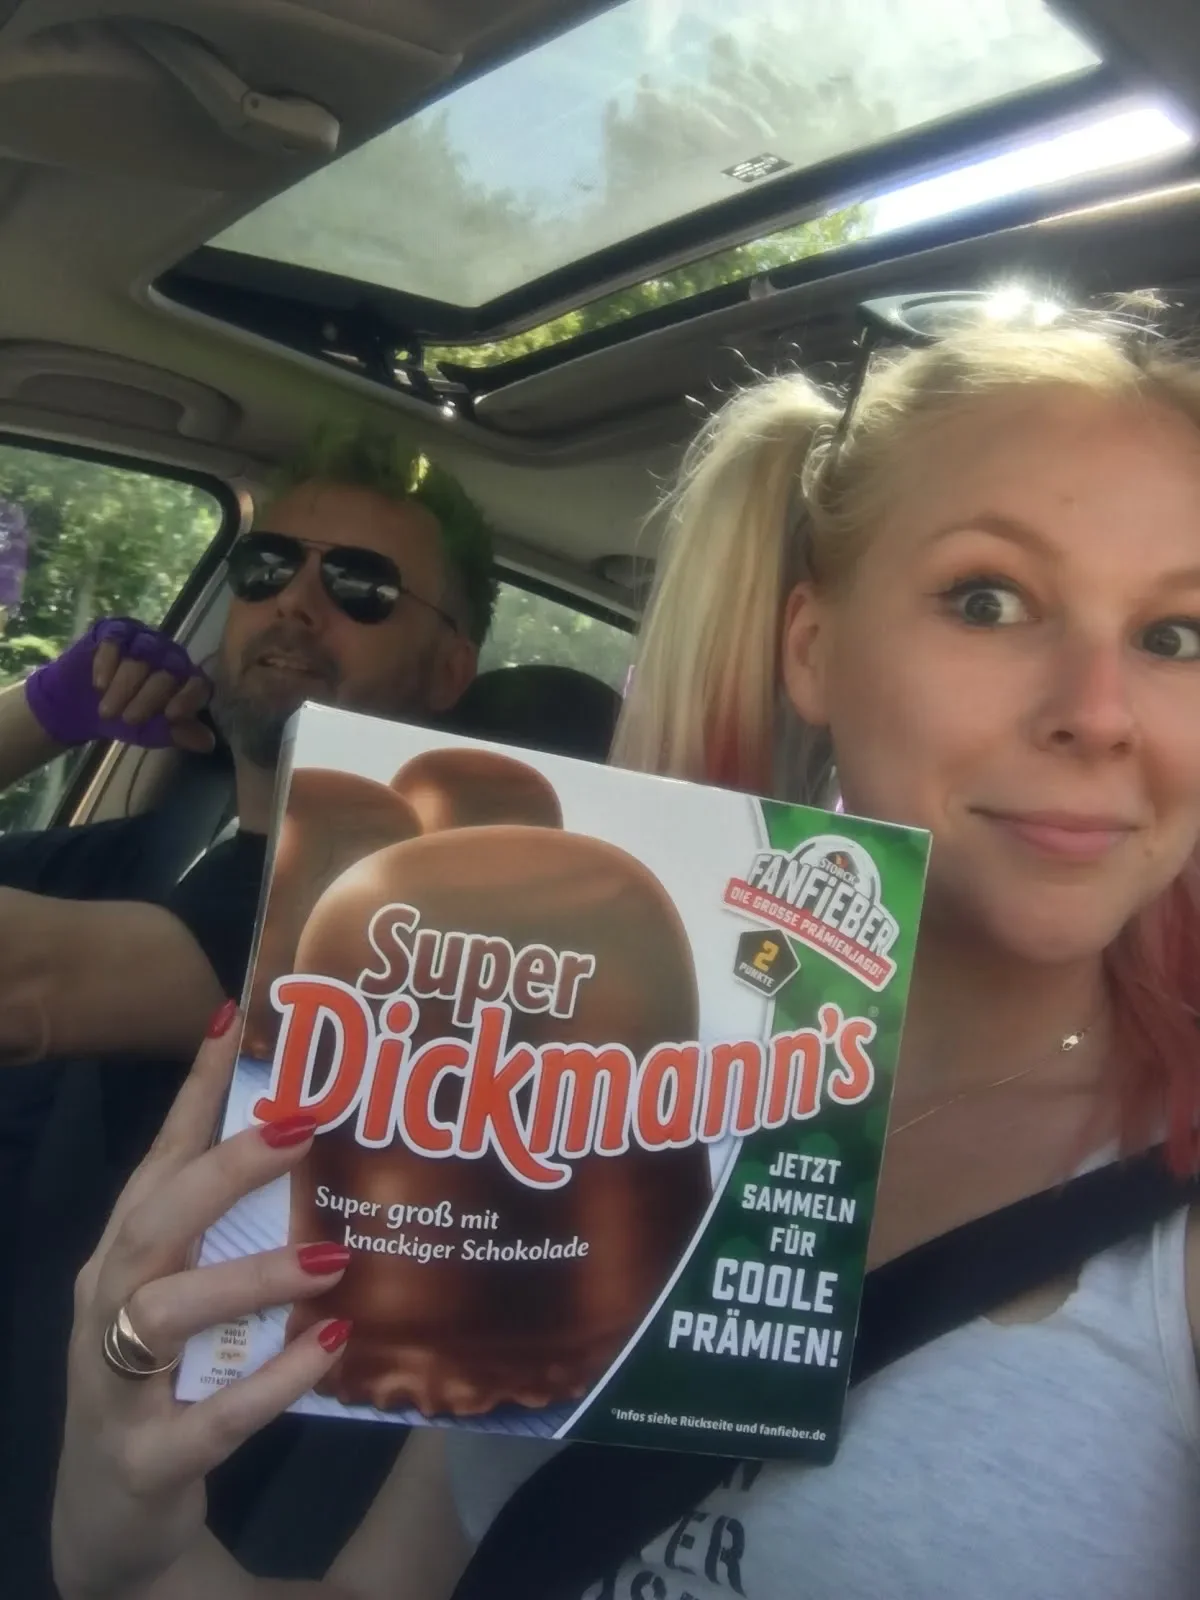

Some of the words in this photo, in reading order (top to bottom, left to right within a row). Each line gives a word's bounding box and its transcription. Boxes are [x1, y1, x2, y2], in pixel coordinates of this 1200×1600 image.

[819, 857, 857, 885] STORCK
[730, 886, 752, 905] DIE
[754, 894, 800, 927] GROSSE
[801, 918, 884, 979] PRÄMIENJAGD!
[356, 903, 595, 1027] Super
[738, 961, 776, 988] PUNKTE
[753, 940, 779, 972] 2
[253, 974, 877, 1190] Dickmann's
[769, 1151, 841, 1185] JETZT
[315, 1186, 381, 1218] Super
[386, 1201, 454, 1229] groß
[461, 1209, 500, 1230] mit
[741, 1183, 856, 1224] SAMMELN
[344, 1225, 456, 1264] knackiger
[461, 1235, 590, 1262] Schokolade
[770, 1223, 816, 1258] FÜR
[712, 1257, 839, 1314] COOLE
[668, 1308, 843, 1368] PRÄMIEN!
[646, 1411, 678, 1427] siehe
[679, 1415, 734, 1432] Rückseite
[735, 1421, 758, 1435] und
[759, 1423, 827, 1442] fanfieber.de
